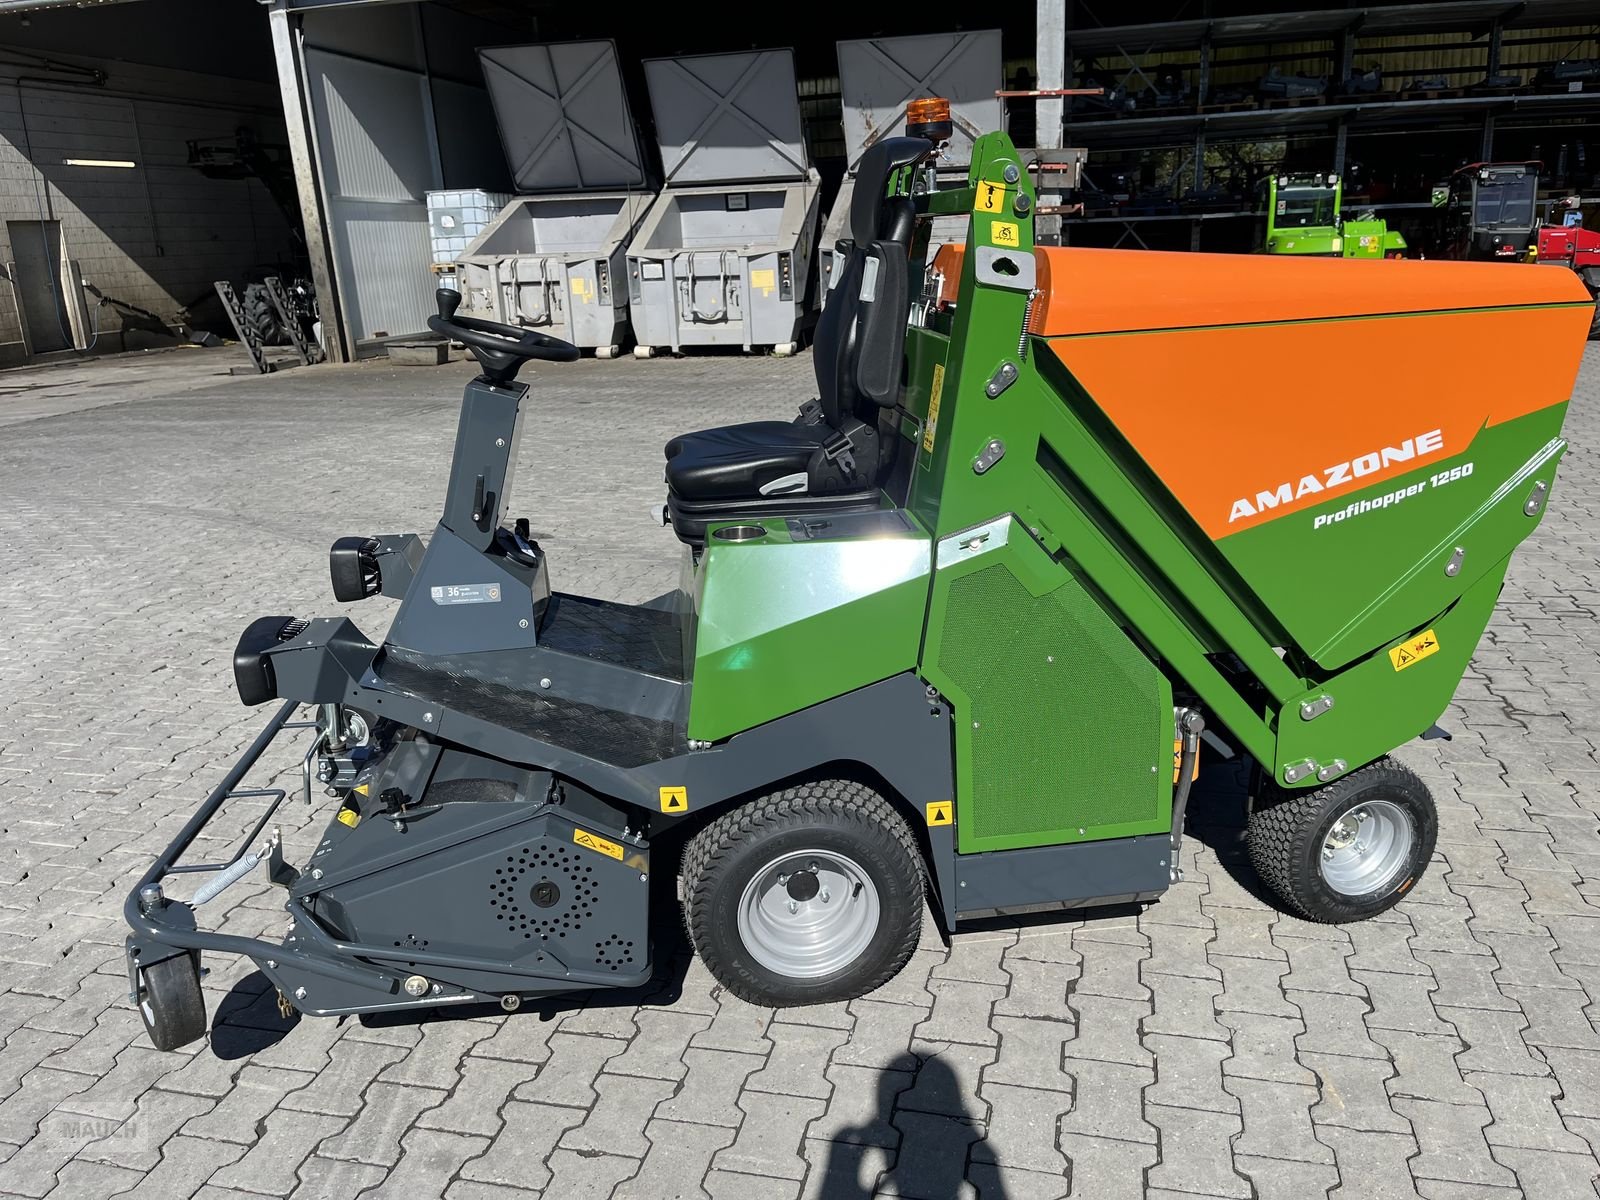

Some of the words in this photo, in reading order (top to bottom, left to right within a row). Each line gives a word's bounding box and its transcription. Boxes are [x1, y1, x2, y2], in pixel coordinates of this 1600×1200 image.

[1228, 428, 1444, 523] AMAZONE
[1313, 480, 1426, 530] Profihopper
[1430, 462, 1474, 488] 1250
[447, 587, 460, 596] 36
